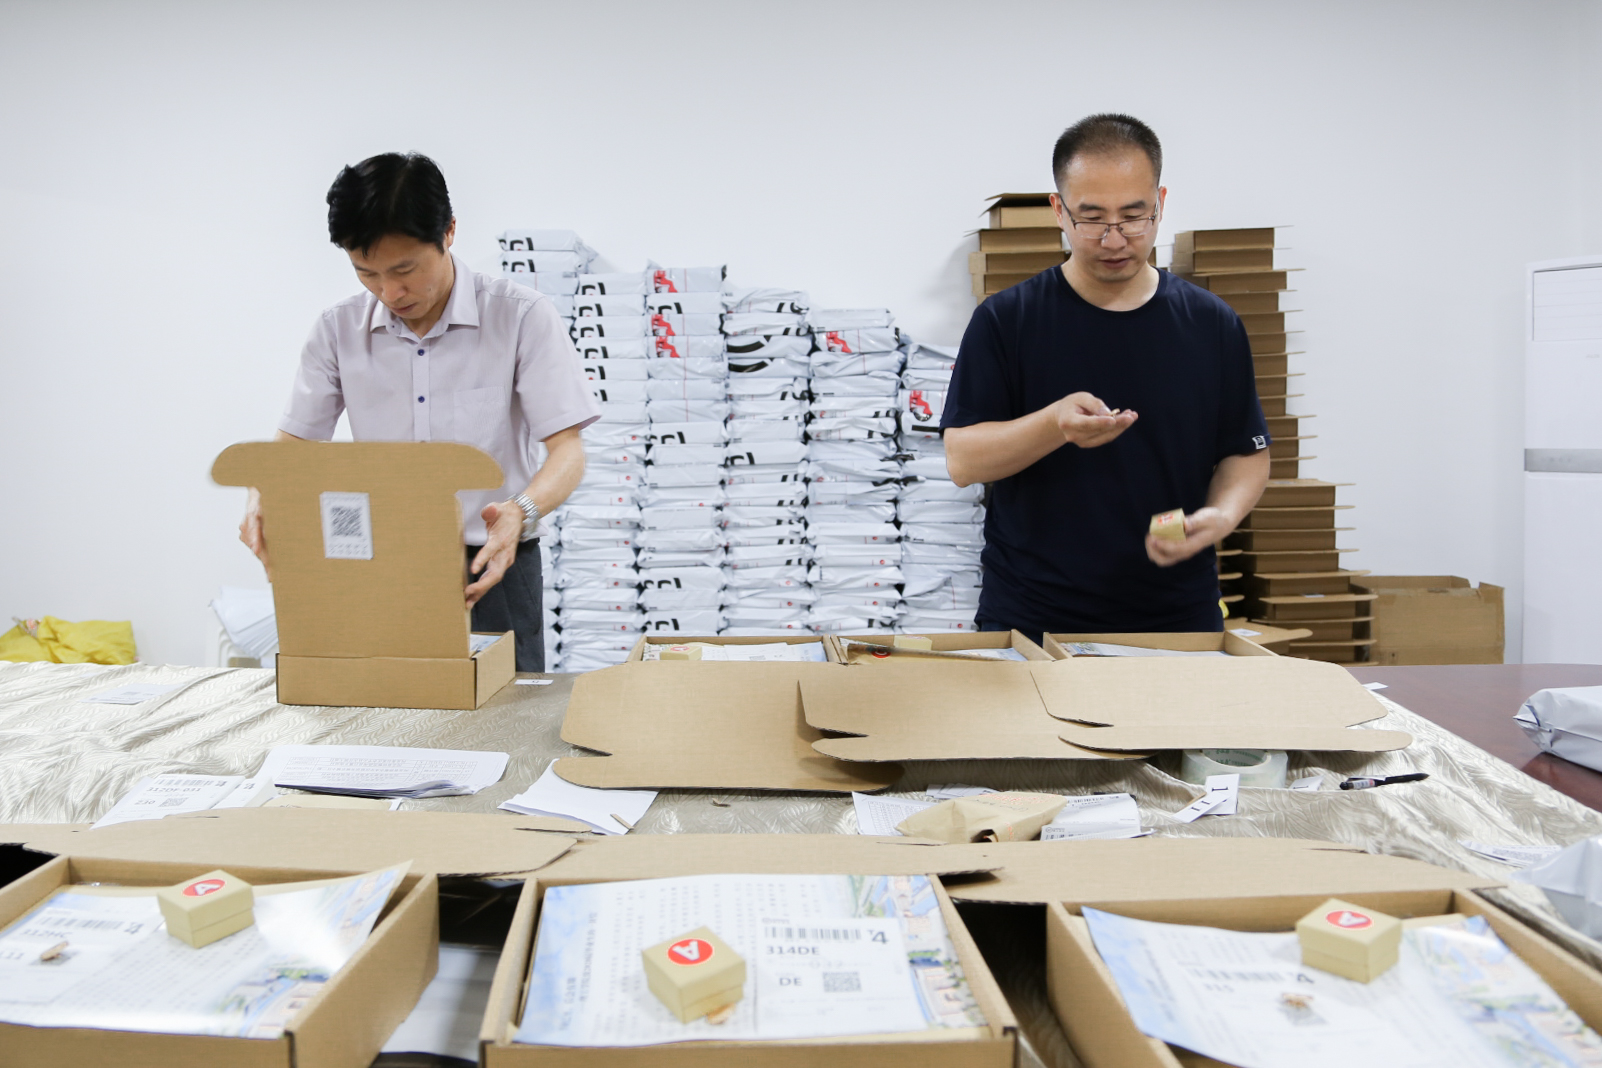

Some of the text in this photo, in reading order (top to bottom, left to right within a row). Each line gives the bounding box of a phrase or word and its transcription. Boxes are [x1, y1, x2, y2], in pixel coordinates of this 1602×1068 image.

[671, 940, 701, 961] A
[766, 946, 821, 955] 314DE
[779, 977, 803, 986] DE
